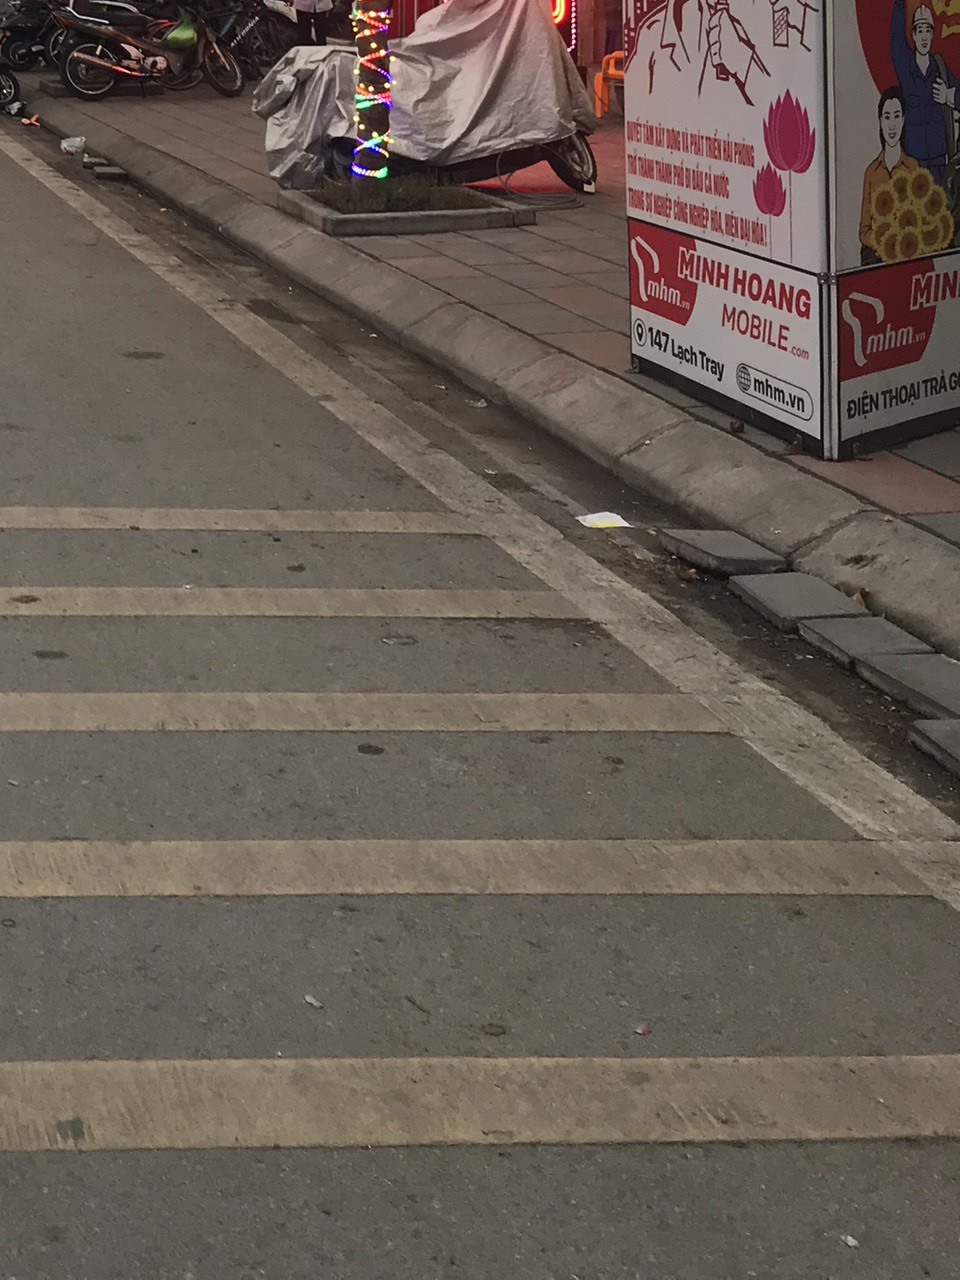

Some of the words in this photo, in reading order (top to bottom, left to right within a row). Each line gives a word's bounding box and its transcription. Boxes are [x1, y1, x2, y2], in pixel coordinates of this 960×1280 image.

[677, 246, 730, 291] MINH
[732, 266, 812, 321] HOANG
[909, 269, 960, 311] MIN
[648, 326, 670, 353] 147
[671, 338, 698, 367] Lạch
[698, 350, 725, 382] Tray
[753, 374, 806, 414] mhm.vn
[846, 390, 880, 420] ĐIỆN
[882, 383, 921, 408] THOẠI
[921, 369, 948, 399] TRẢ
